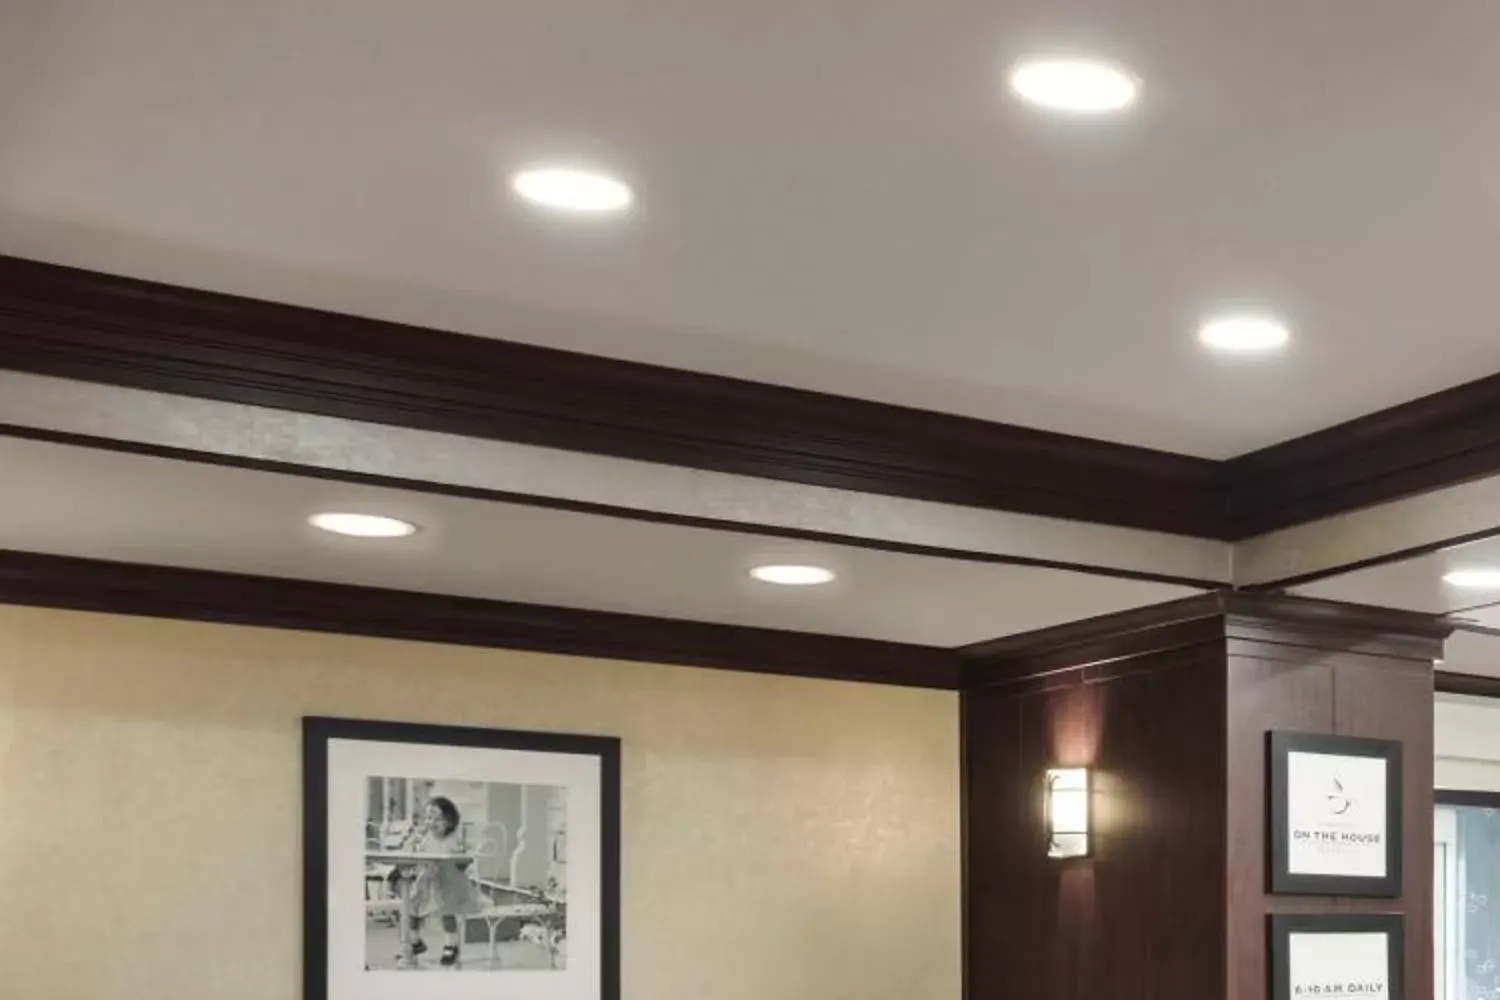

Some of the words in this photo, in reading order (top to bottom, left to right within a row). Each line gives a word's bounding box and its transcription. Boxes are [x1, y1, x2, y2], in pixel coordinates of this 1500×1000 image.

[1293, 828, 1311, 840] ON
[1313, 830, 1338, 841] THE
[1340, 831, 1381, 844] HOUSE
[1346, 981, 1384, 994] DAILY
